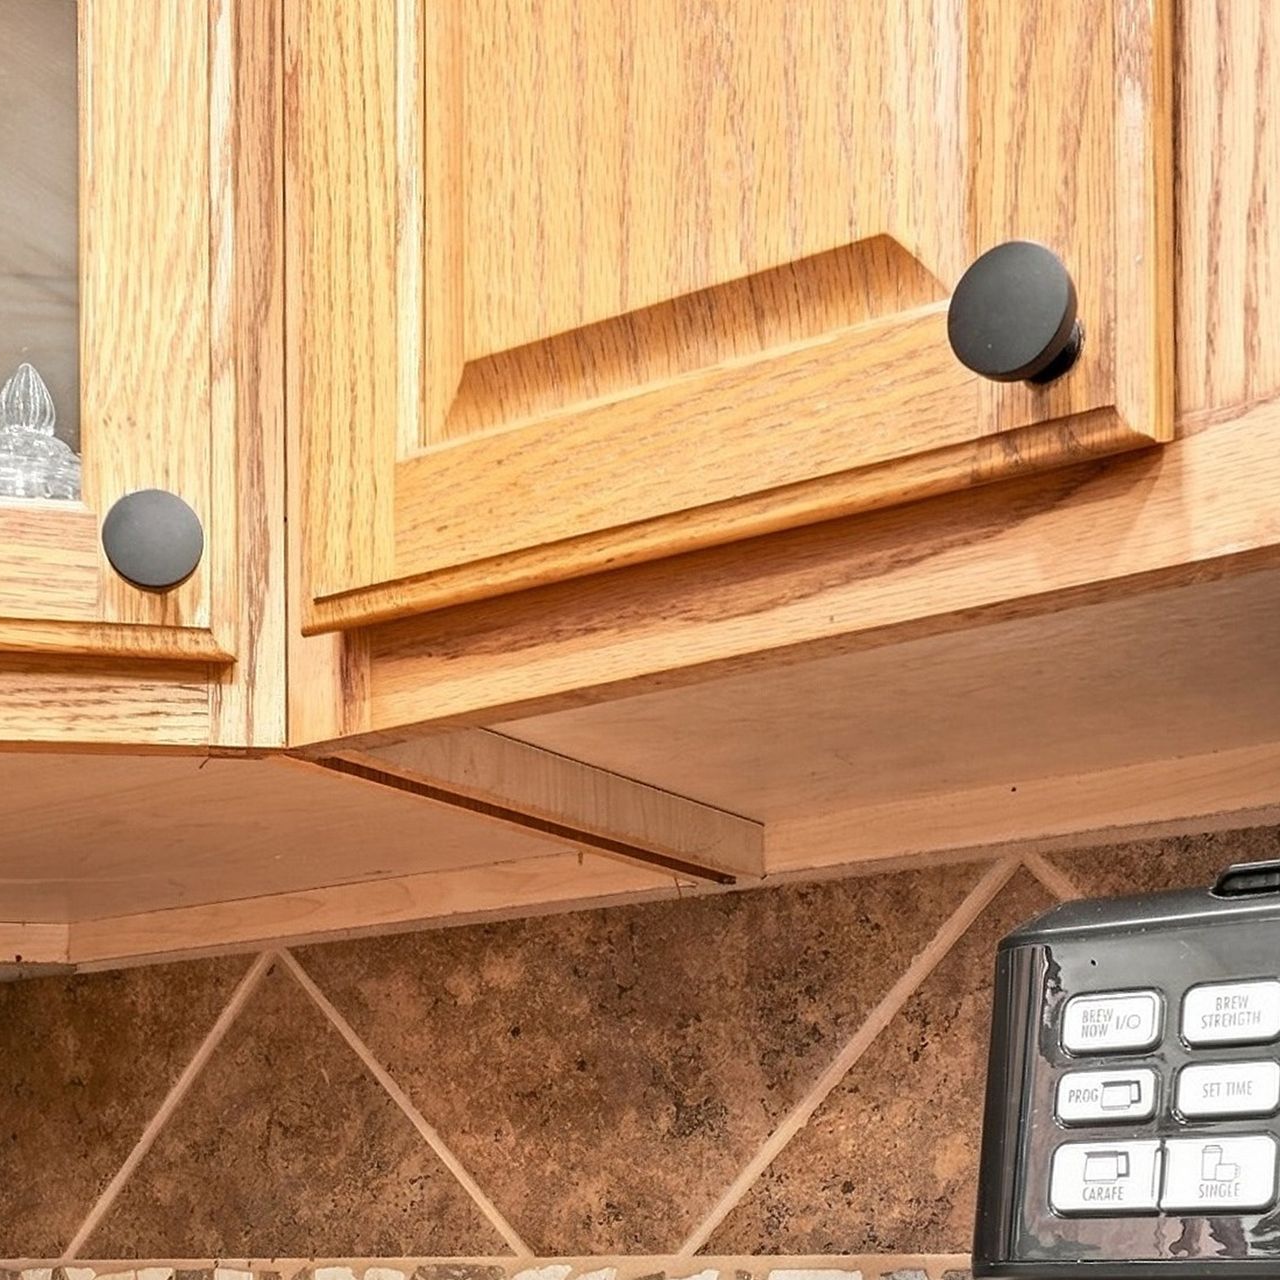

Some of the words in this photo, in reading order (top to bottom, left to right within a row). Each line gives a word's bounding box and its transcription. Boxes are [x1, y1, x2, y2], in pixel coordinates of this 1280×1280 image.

[1215, 995, 1249, 1011] BREW
[1081, 1007, 1114, 1023] BREW
[1200, 1010, 1262, 1030] STRENGTH
[1080, 1023, 1109, 1039] NOW
[1067, 1087, 1099, 1104] PROG
[1202, 1083, 1221, 1099] SET
[1225, 1080, 1254, 1097] TIME
[1081, 1185, 1124, 1202] CARAFE
[1198, 1182, 1242, 1199] SINGLE
